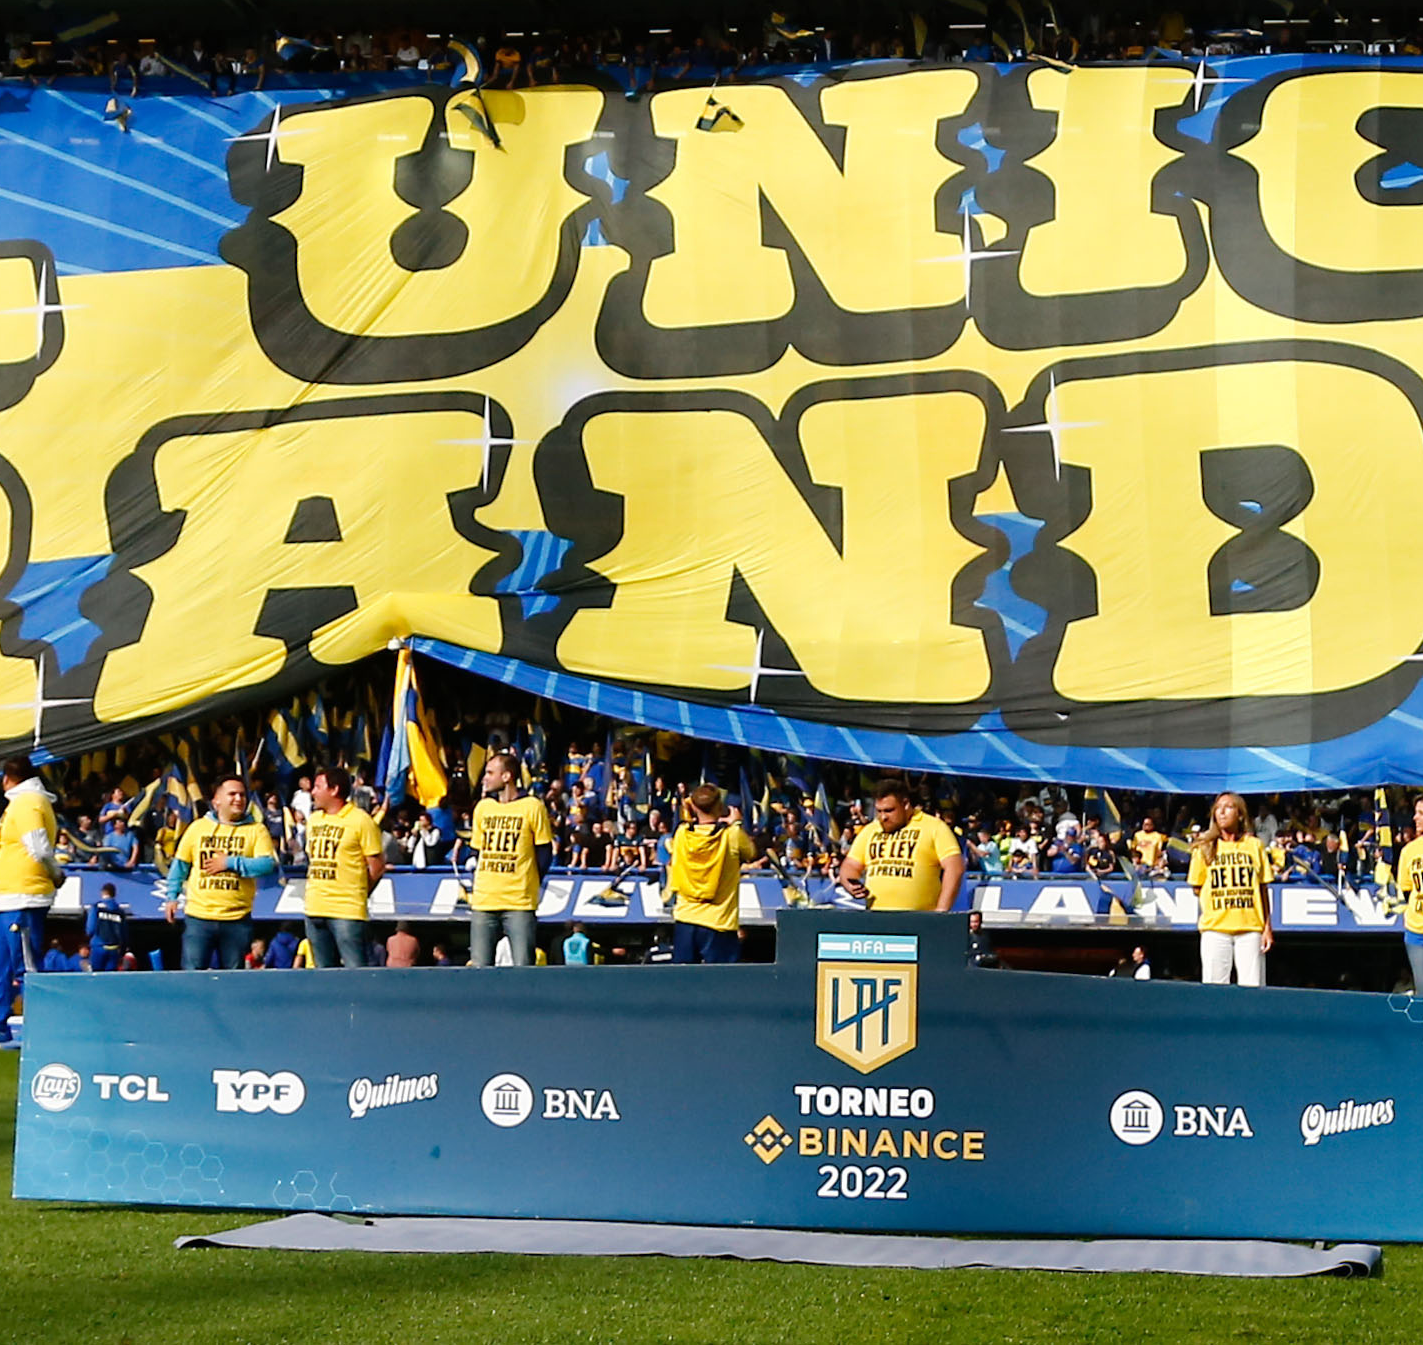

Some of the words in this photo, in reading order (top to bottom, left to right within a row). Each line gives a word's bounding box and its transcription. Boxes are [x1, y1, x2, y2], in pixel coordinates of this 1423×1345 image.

[496, 831, 520, 852] LEY
[869, 841, 886, 860] DE
[889, 841, 917, 859] LEY
[877, 866, 913, 878] PREVIA
[1211, 868, 1227, 888] DE
[1231, 867, 1254, 887] LEY
[980, 886, 1094, 923] LA
[1213, 899, 1222, 910] LA
[1224, 898, 1254, 910] PREVIA
[851, 940, 884, 954] AFA
[92, 1074, 169, 1102] TCL
[230, 1082, 292, 1100] YPF
[348, 1073, 438, 1119] Quilmes
[794, 1085, 934, 1118] TORNEO
[542, 1088, 620, 1120] BNA
[1173, 1106, 1254, 1137] BNA
[1301, 1099, 1395, 1146] Quilmes
[798, 1127, 985, 1160] BINANCE
[817, 1165, 908, 1199] 2022
